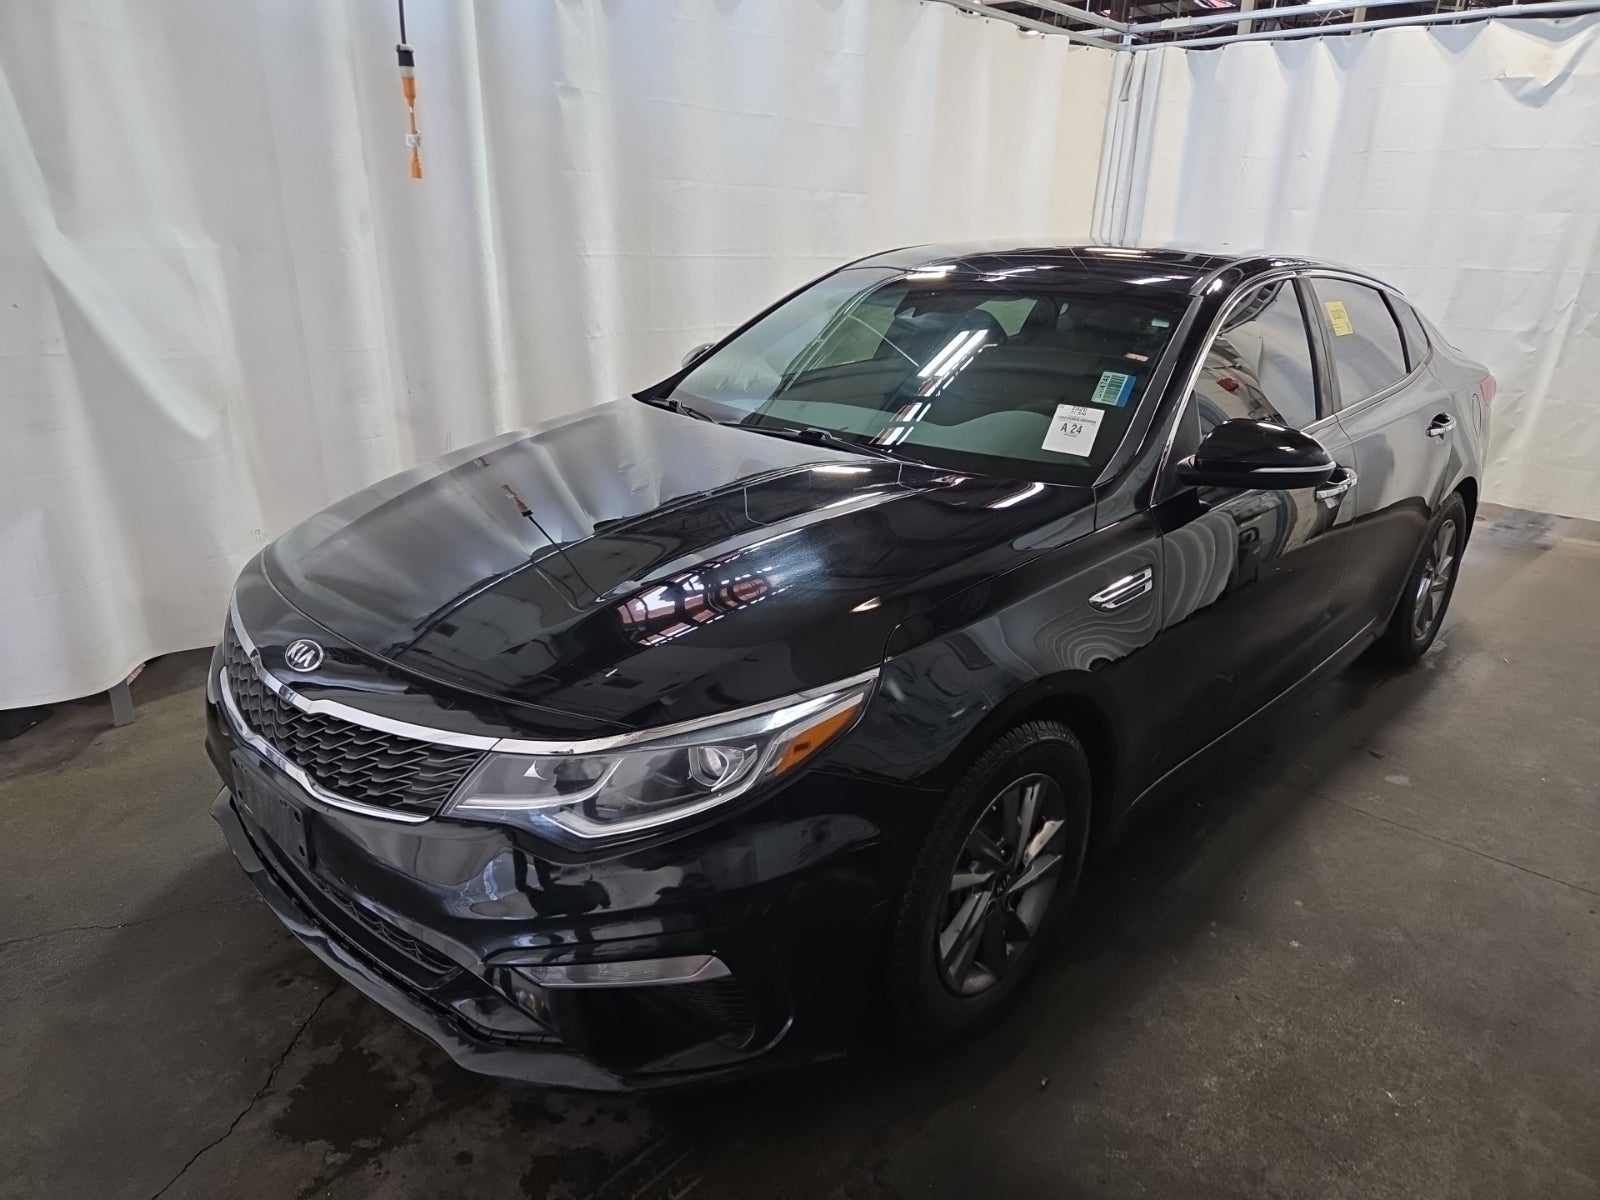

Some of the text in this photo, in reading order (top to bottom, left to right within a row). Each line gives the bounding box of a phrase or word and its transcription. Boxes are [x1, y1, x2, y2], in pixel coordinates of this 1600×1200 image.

[1060, 422, 1083, 435] A 24
[287, 641, 317, 668] KIA
